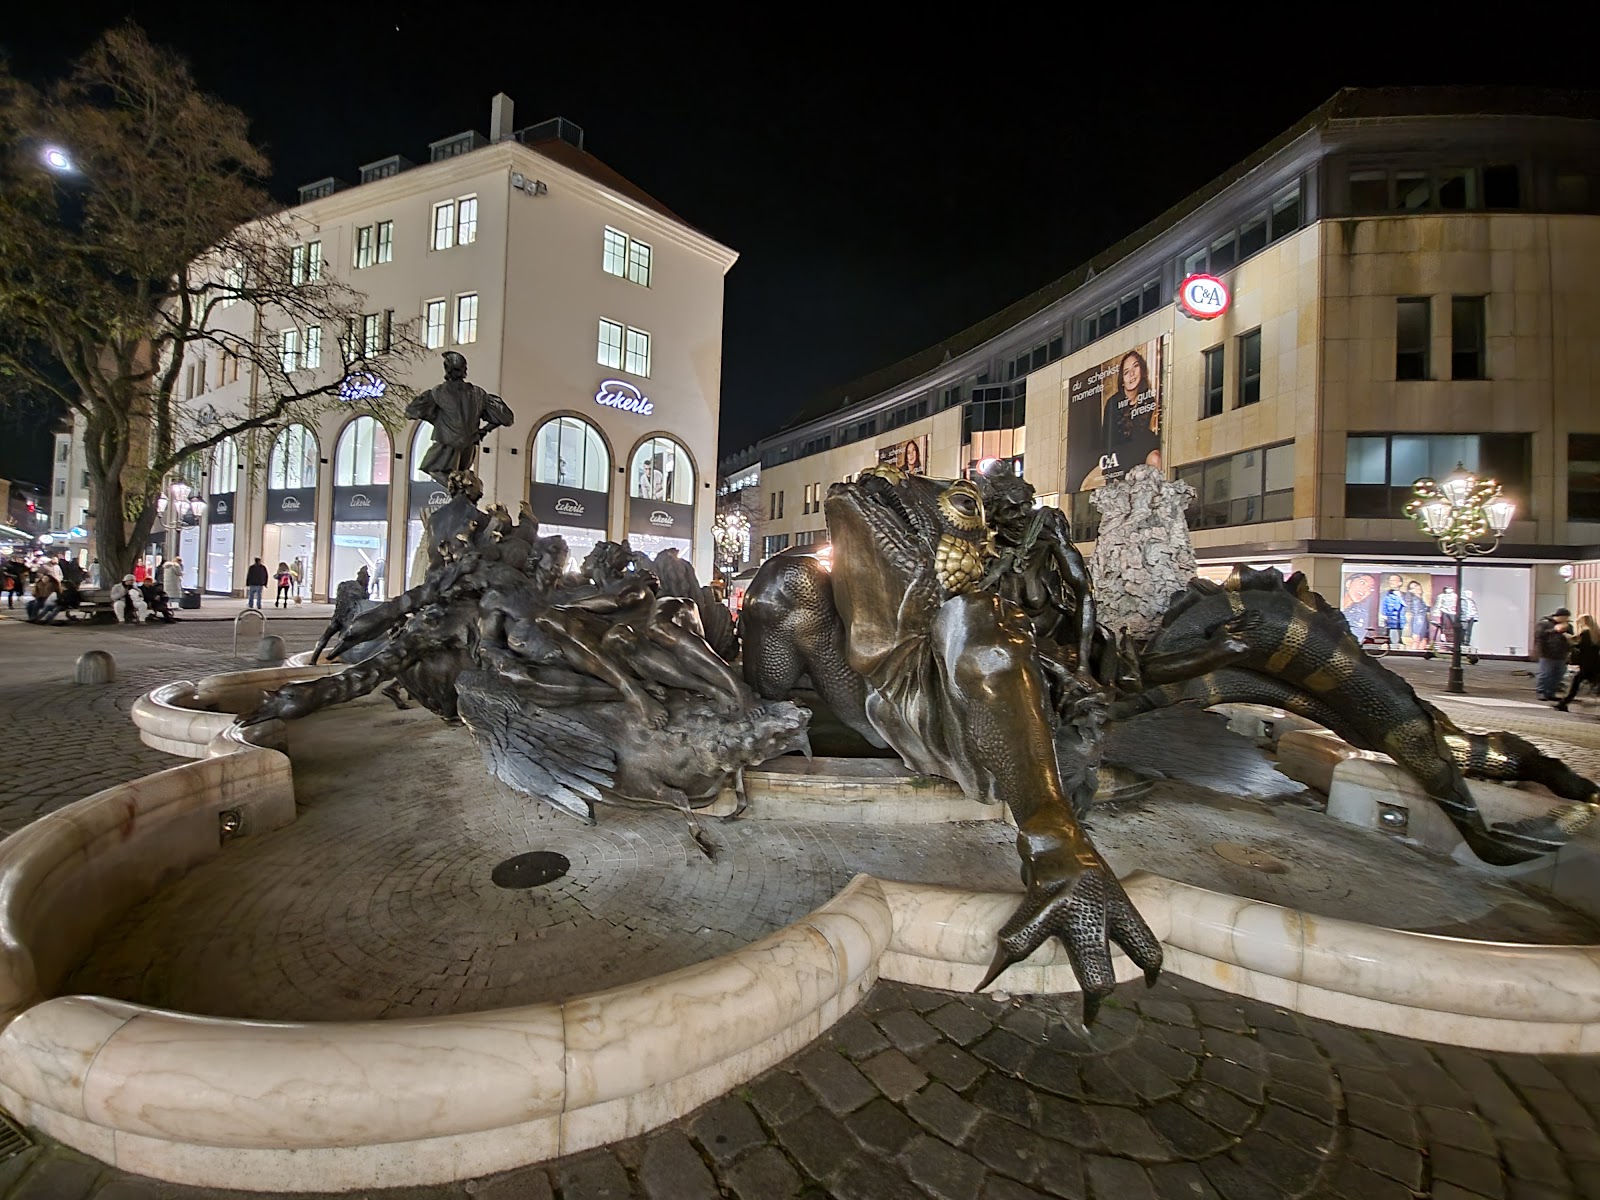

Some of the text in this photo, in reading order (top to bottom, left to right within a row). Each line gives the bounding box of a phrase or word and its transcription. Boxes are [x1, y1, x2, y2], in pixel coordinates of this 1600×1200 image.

[1191, 285, 1221, 306] C&A
[1072, 364, 1120, 391] du schenkst
[595, 380, 654, 415] Eckerle
[1072, 384, 1104, 403] momente
[1118, 389, 1156, 409] wir gute
[1131, 401, 1156, 419] preise
[555, 498, 585, 513] Eckerle
[650, 511, 674, 525] Eckerle
